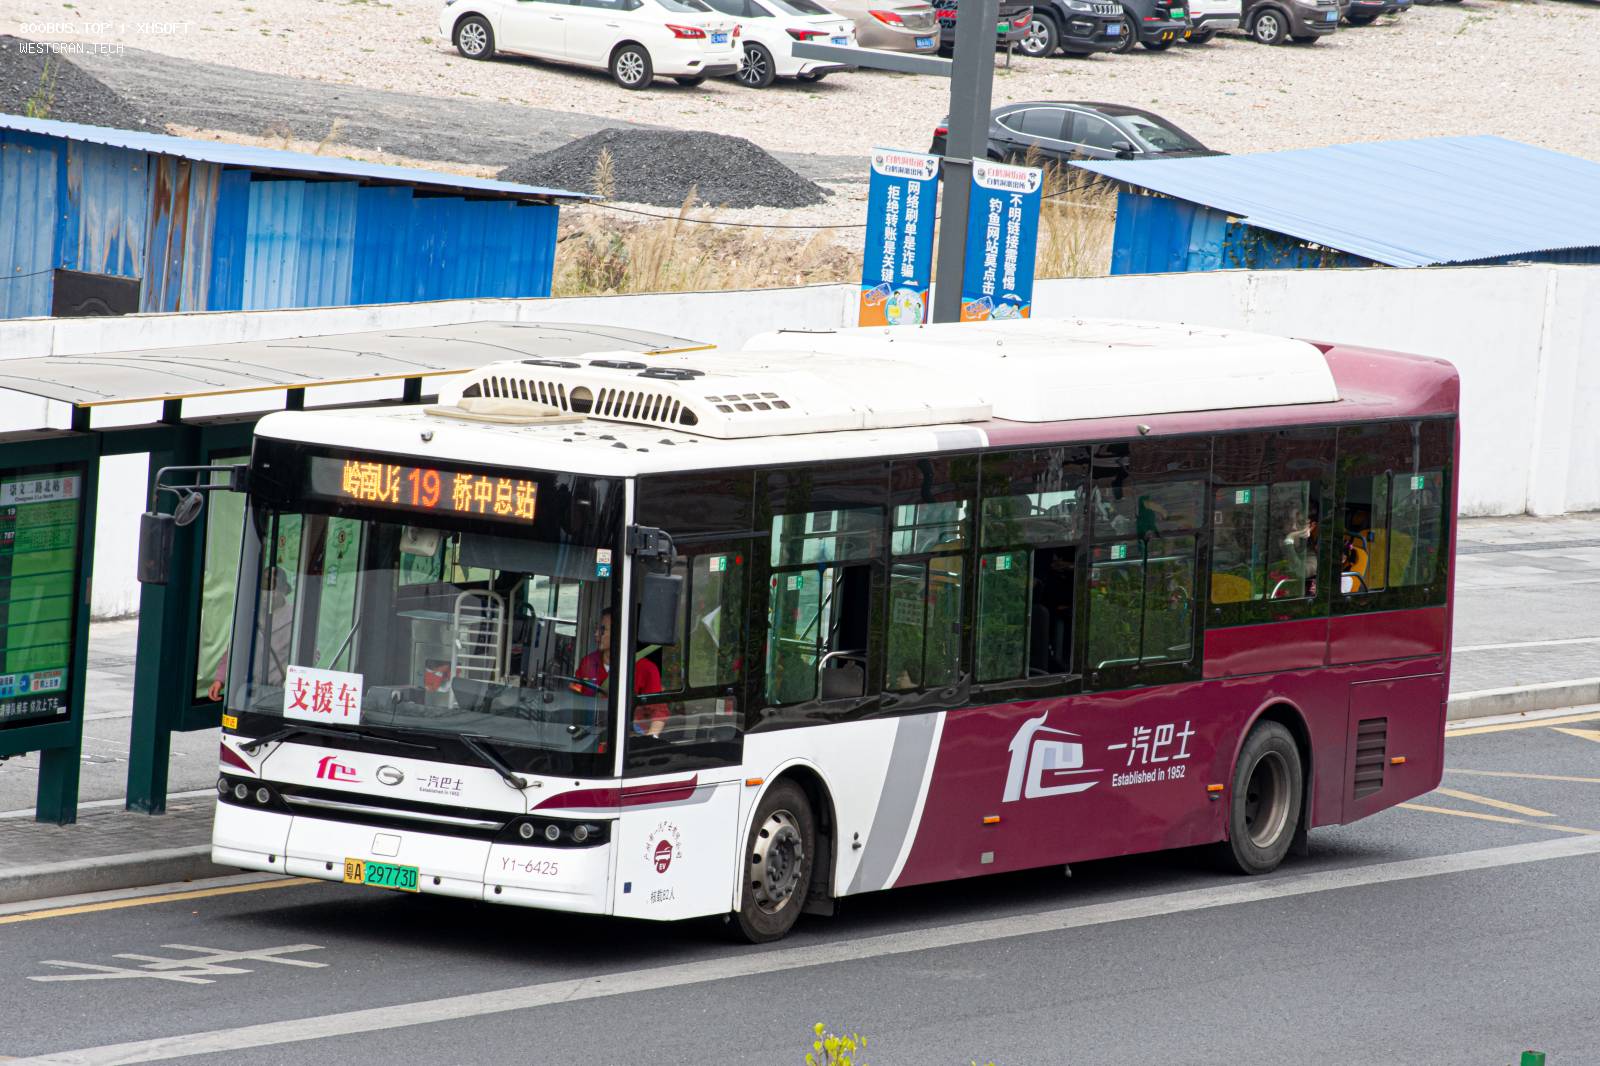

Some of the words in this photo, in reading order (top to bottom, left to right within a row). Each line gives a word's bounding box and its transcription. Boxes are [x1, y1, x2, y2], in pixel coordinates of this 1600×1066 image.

[881, 184, 900, 283] 拒绝转账是关键
[901, 181, 920, 278] 网络刷单是诈骗
[982, 197, 1002, 295] 钓鱼网站莫点击
[1003, 193, 1023, 290] 不明链接需警惕
[408, 467, 441, 508] 19
[452, 473, 538, 519] 桥中总站
[288, 677, 360, 717] 支援车
[1107, 720, 1196, 766] 一汽巴士
[416, 775, 463, 791] 一汽巴士
[1112, 769, 1156, 787] Established
[1157, 767, 1165, 780] in
[1167, 765, 1185, 779] 1952
[501, 856, 558, 876] Y1-6425
